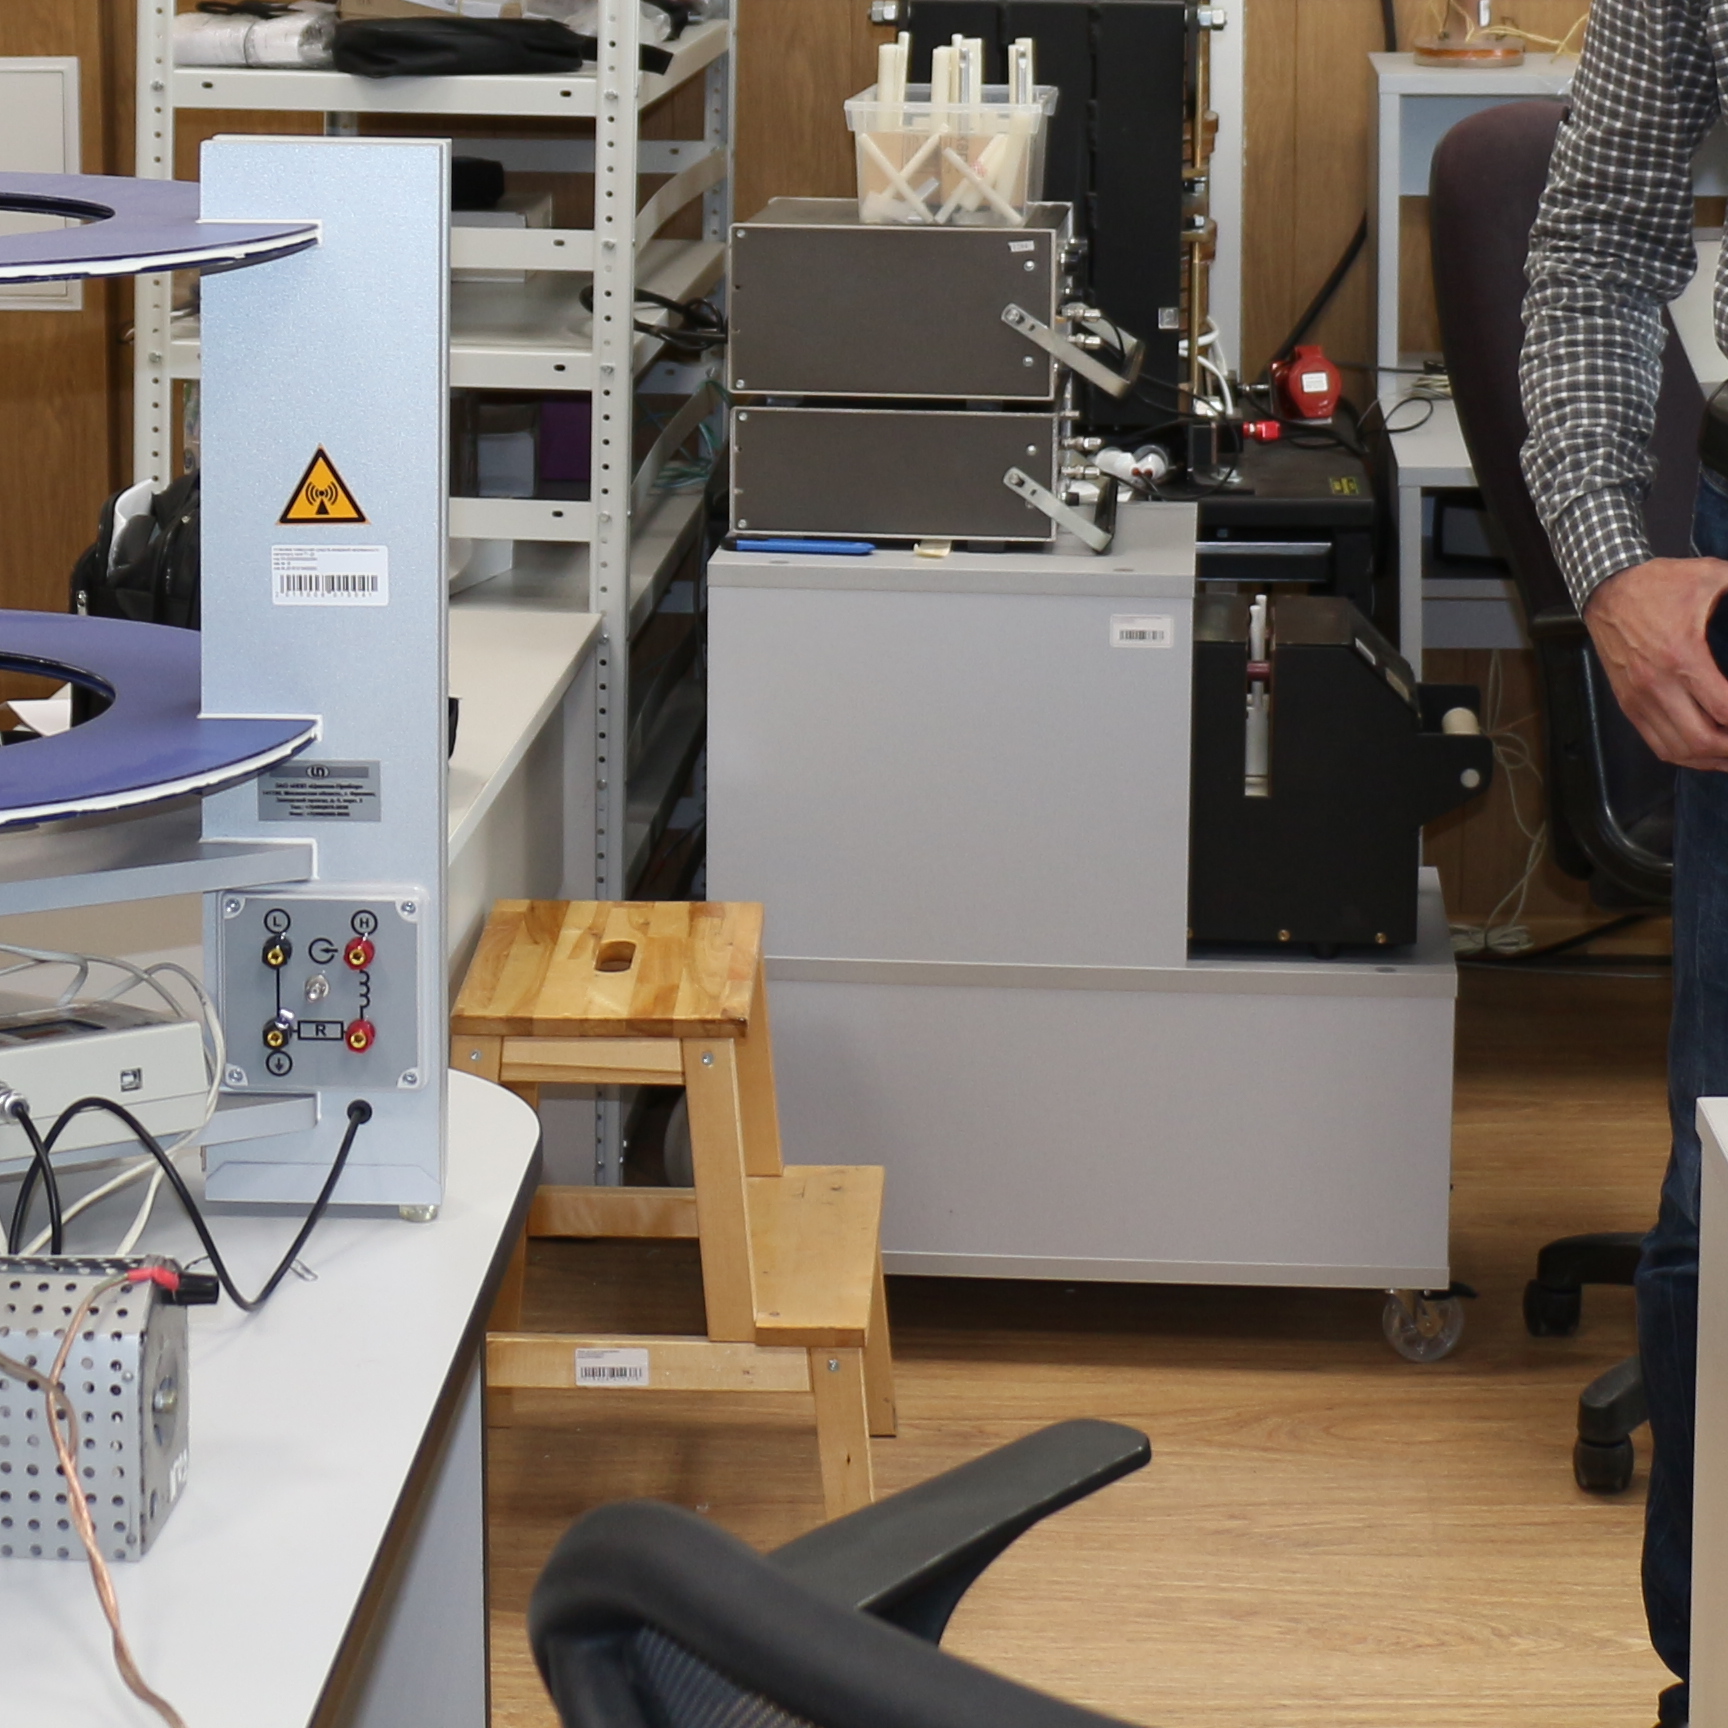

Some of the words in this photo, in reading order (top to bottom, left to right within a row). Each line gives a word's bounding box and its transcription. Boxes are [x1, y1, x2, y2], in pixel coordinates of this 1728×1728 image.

[273, 916, 282, 927] L
[359, 917, 370, 929] H
[315, 1024, 326, 1037] R
